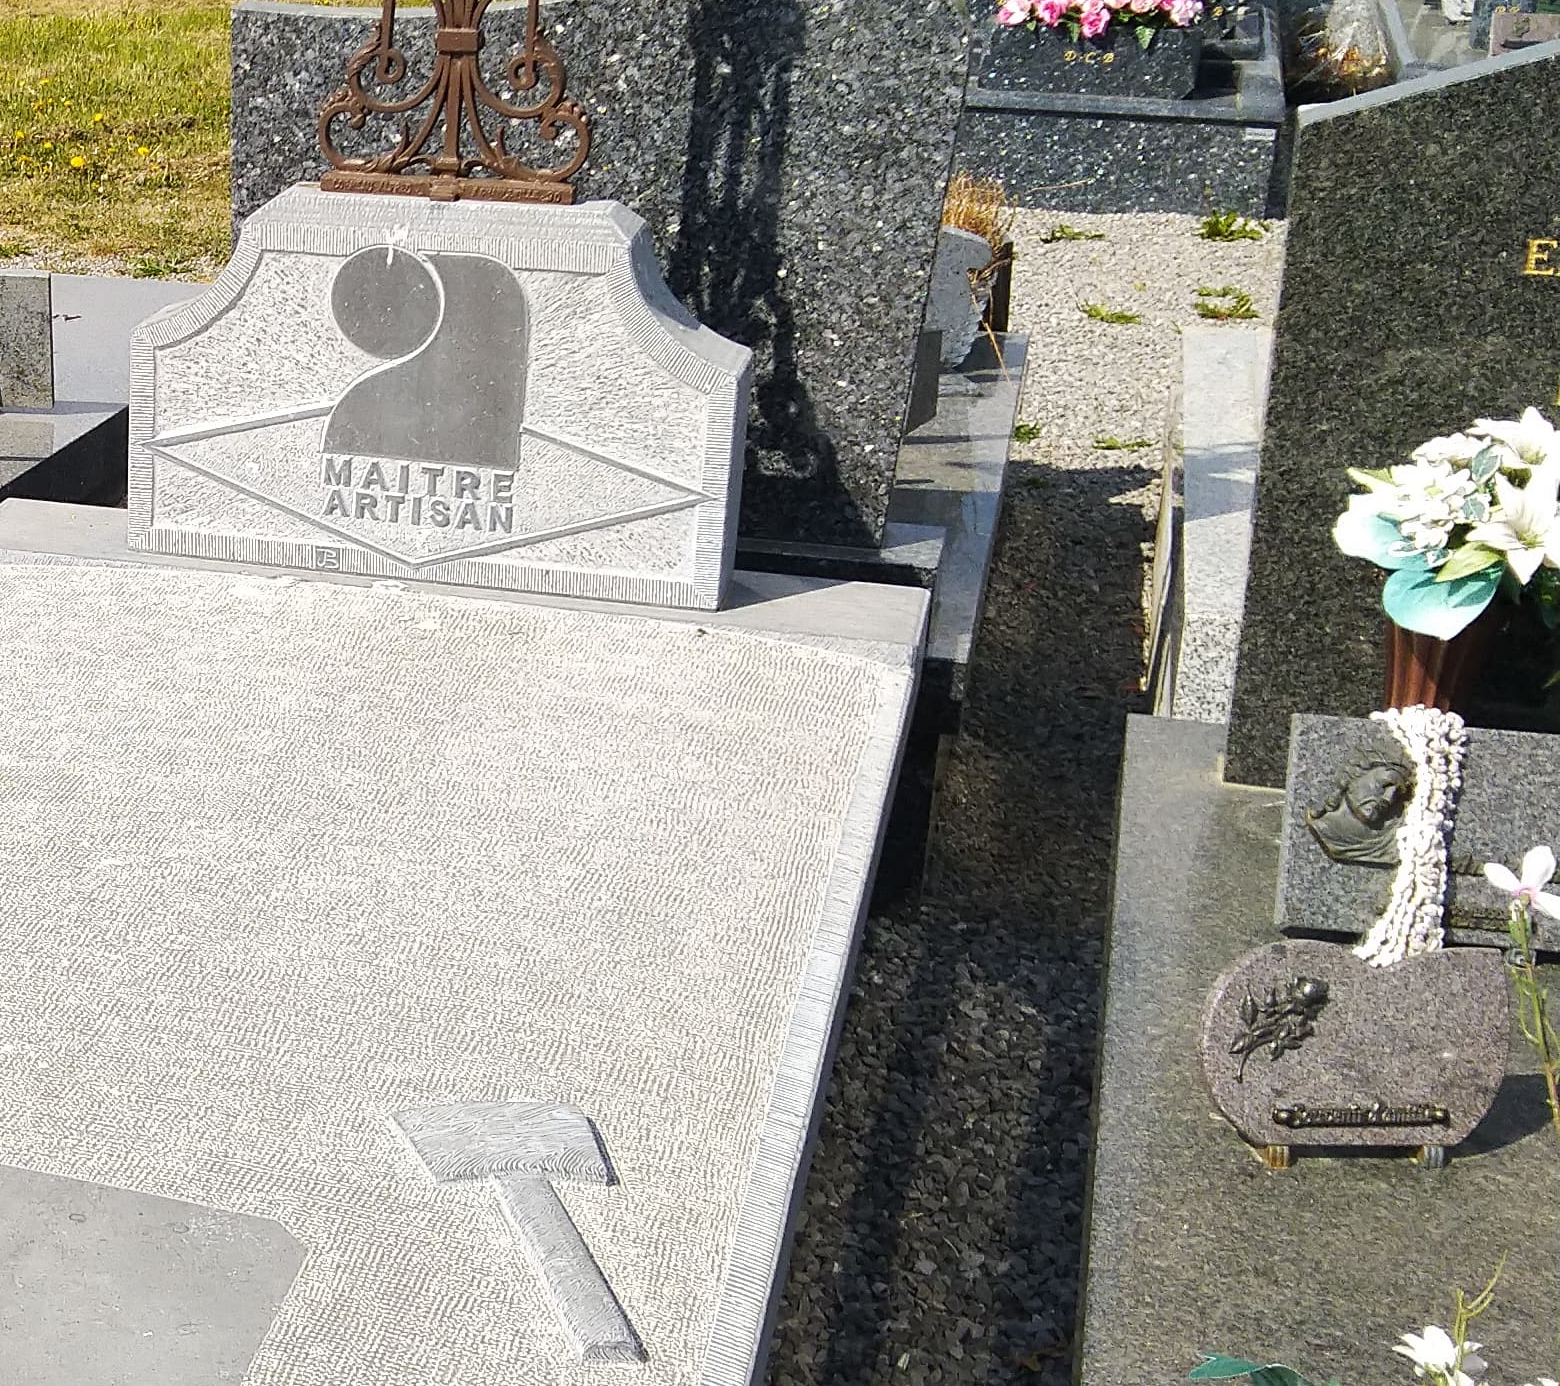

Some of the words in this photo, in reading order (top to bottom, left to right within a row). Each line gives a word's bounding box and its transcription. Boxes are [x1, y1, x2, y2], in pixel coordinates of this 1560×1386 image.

[1523, 238, 1560, 276] E
[321, 455, 517, 504] MAITRE
[322, 489, 515, 534] ARTISAN
